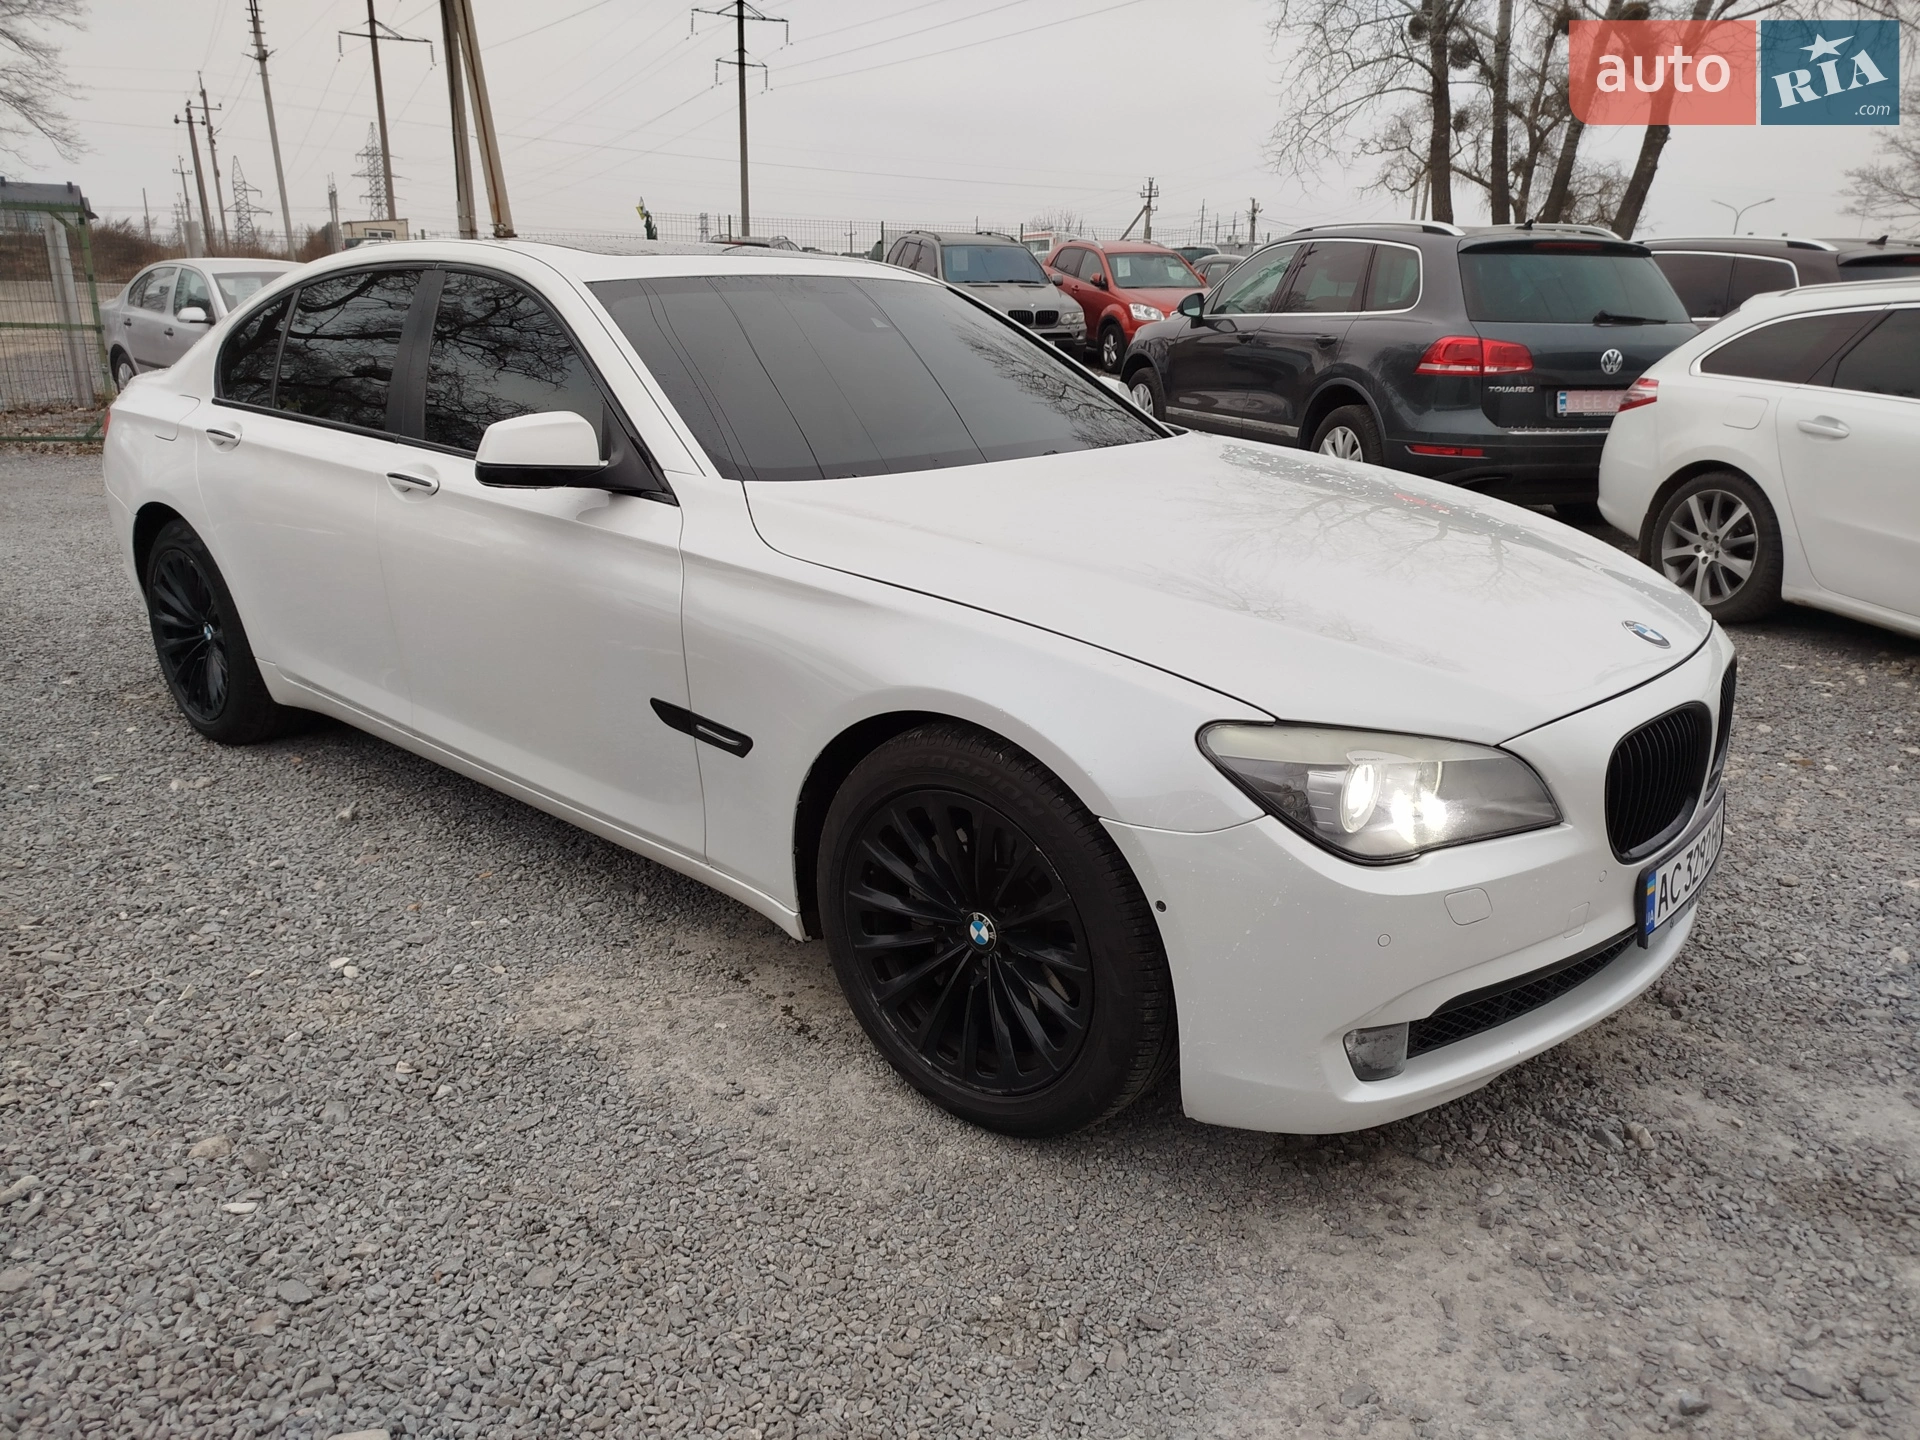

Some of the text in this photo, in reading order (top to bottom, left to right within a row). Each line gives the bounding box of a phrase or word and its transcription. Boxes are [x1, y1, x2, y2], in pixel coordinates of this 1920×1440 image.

[1488, 385, 1535, 394] TOUAREG
[1657, 861, 1682, 919] AC
[1684, 827, 1711, 892] 3292
